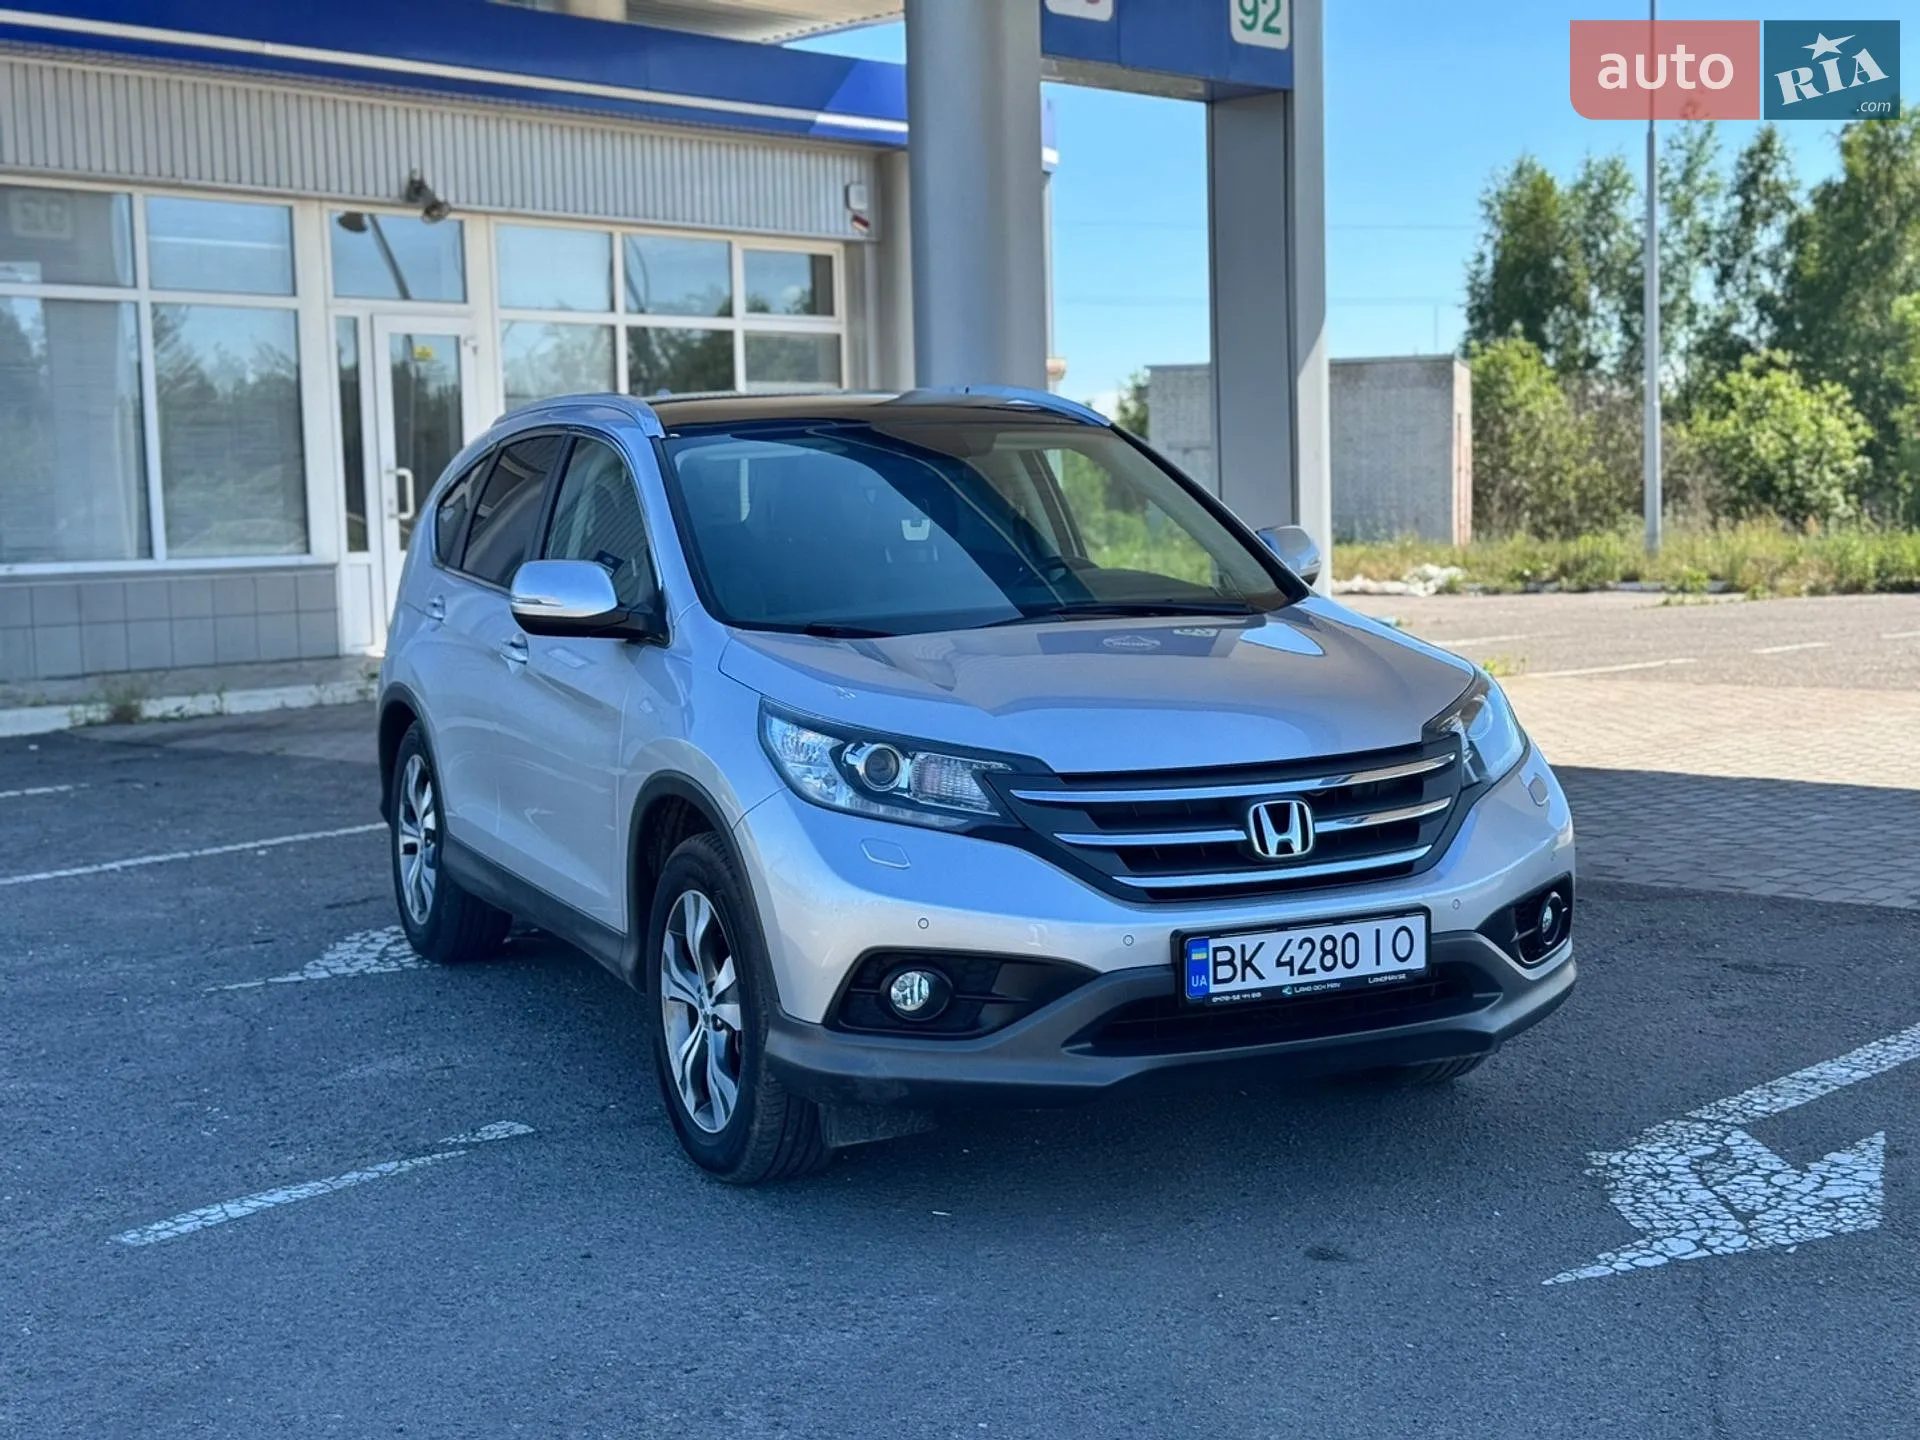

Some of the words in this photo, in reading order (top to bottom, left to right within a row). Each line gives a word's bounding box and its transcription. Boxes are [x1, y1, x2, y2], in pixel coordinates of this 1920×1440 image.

[1238, 0, 1282, 35] 92
[1212, 941, 1266, 985] BK
[1275, 931, 1360, 977] 4280
[1191, 975, 1208, 988] UA
